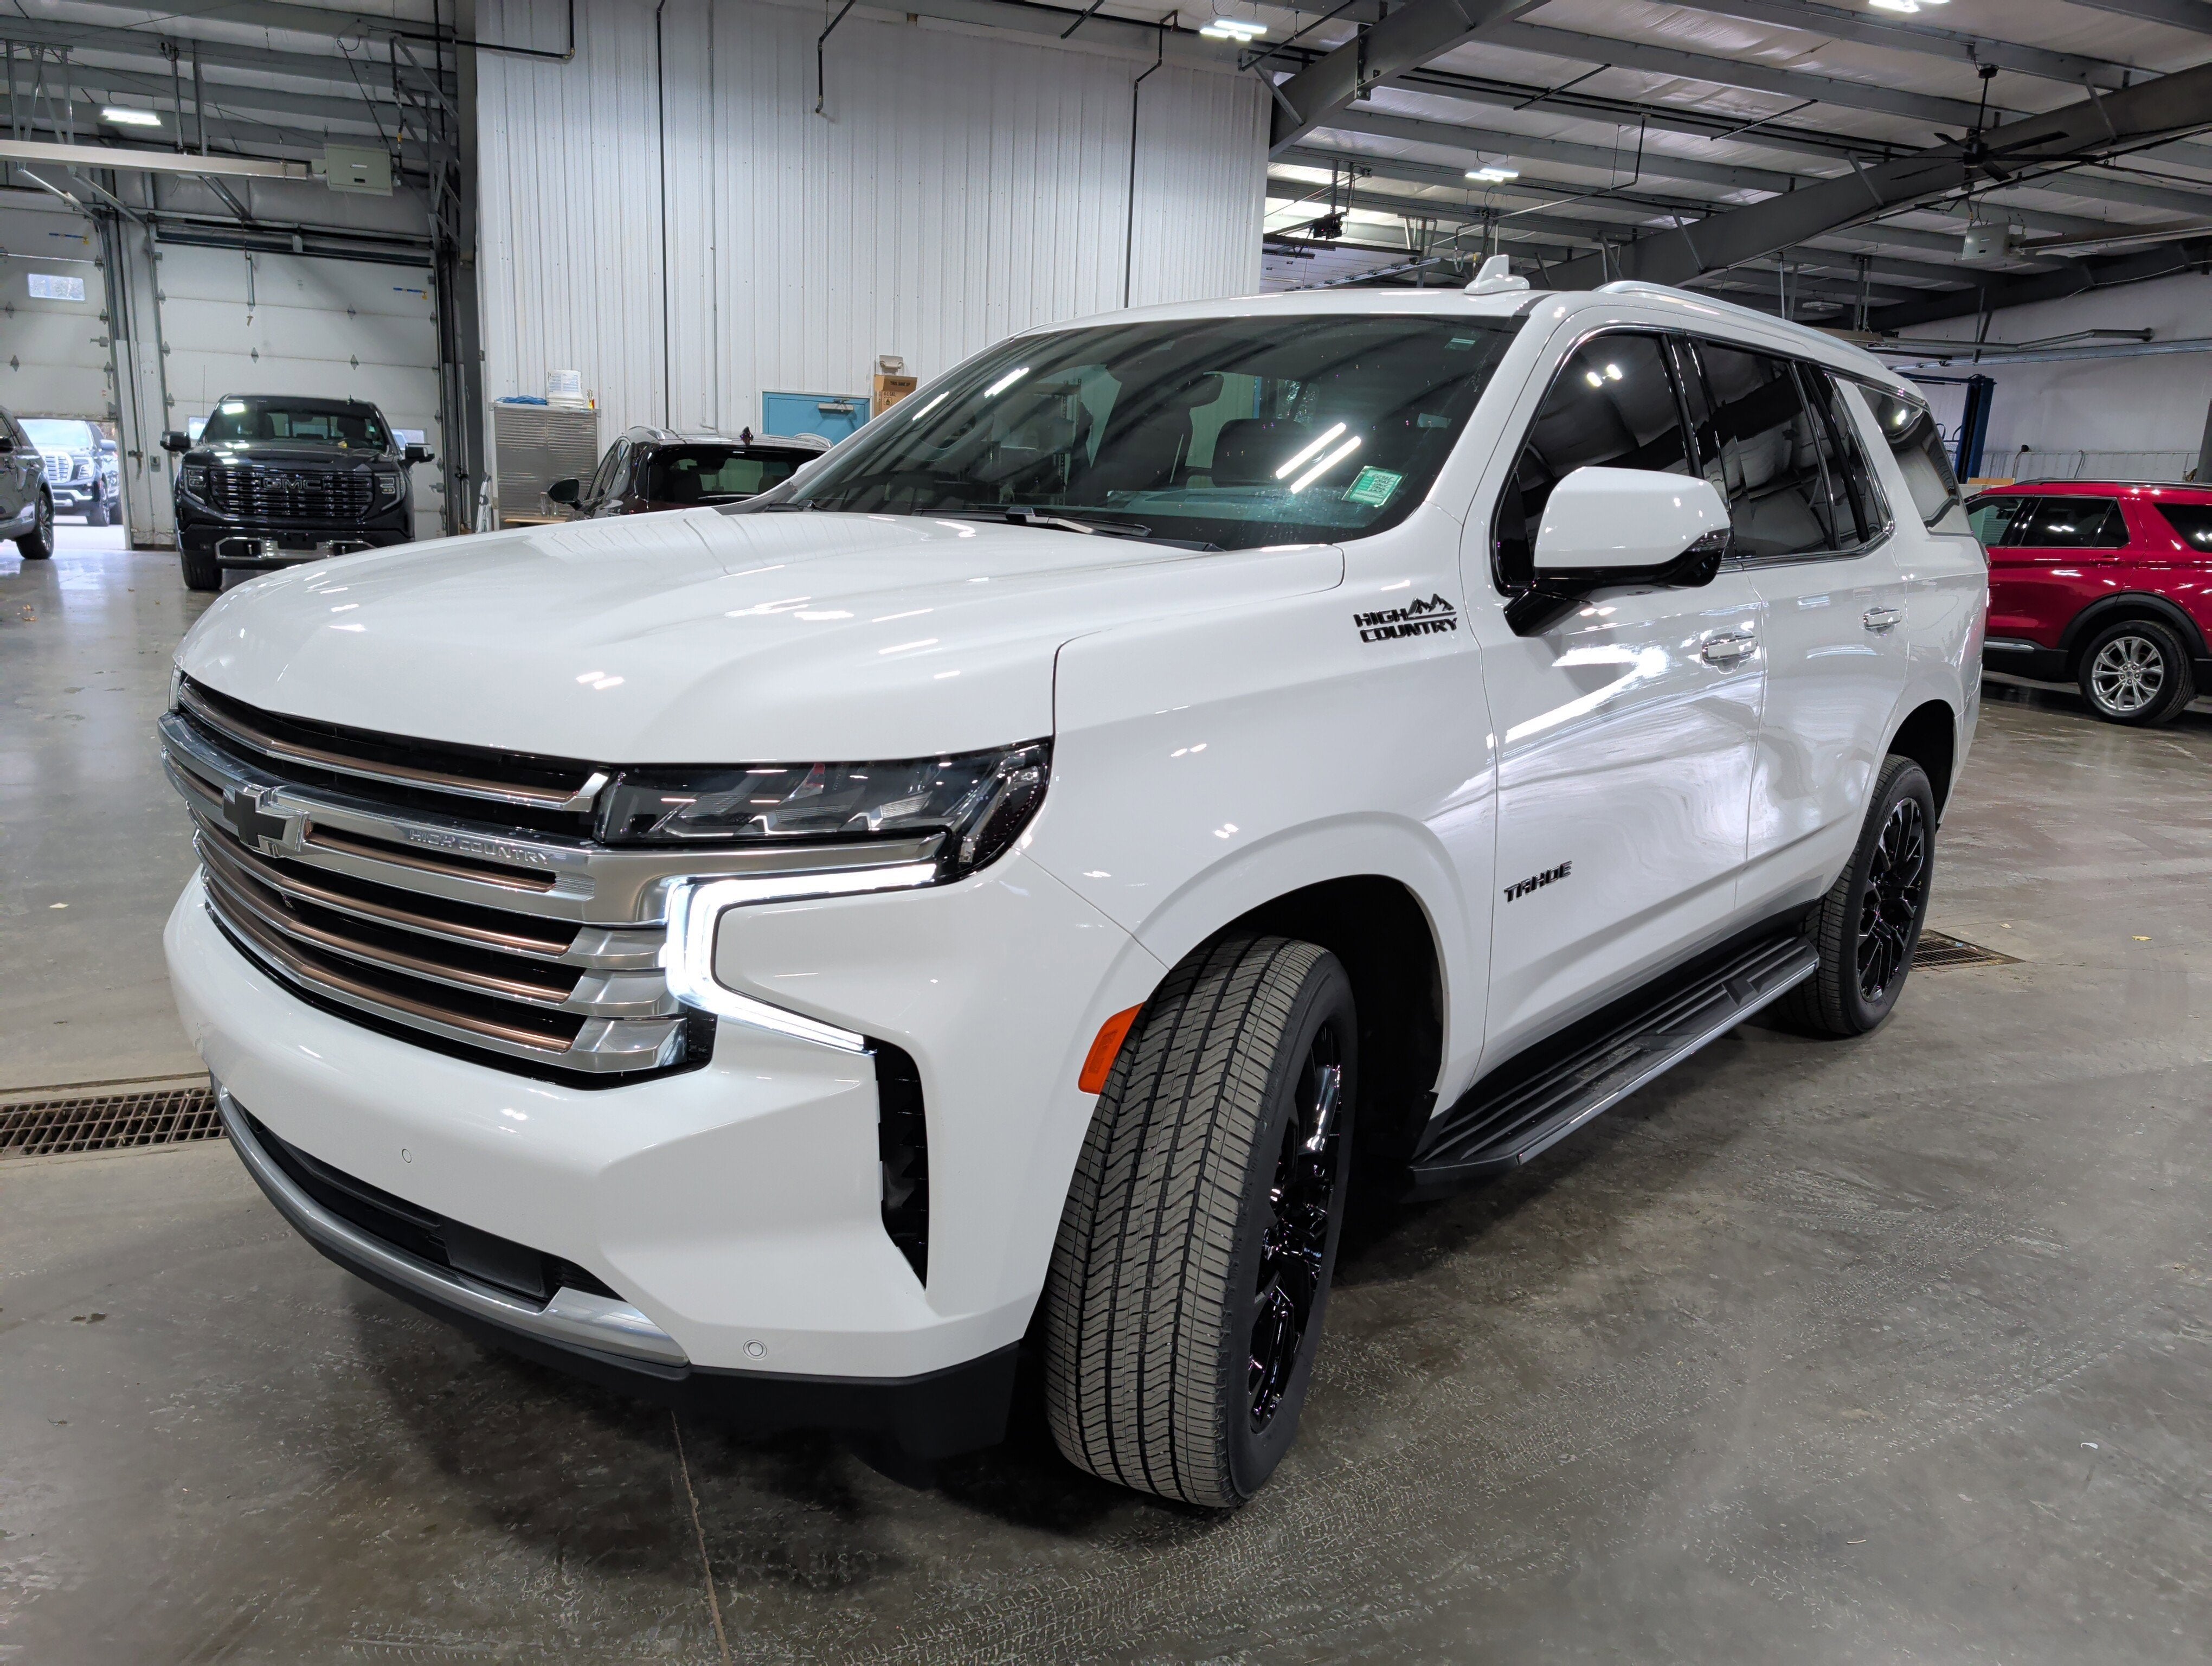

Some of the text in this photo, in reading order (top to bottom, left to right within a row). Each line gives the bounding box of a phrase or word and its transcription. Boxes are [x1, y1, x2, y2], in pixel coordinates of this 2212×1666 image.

[262, 477, 322, 490] GMC
[1353, 608, 1409, 627] HIGH
[1360, 617, 1458, 643] COUNTRY
[409, 830, 554, 864] HIGH COUNTRY
[1504, 861, 1572, 902] TAHOE
